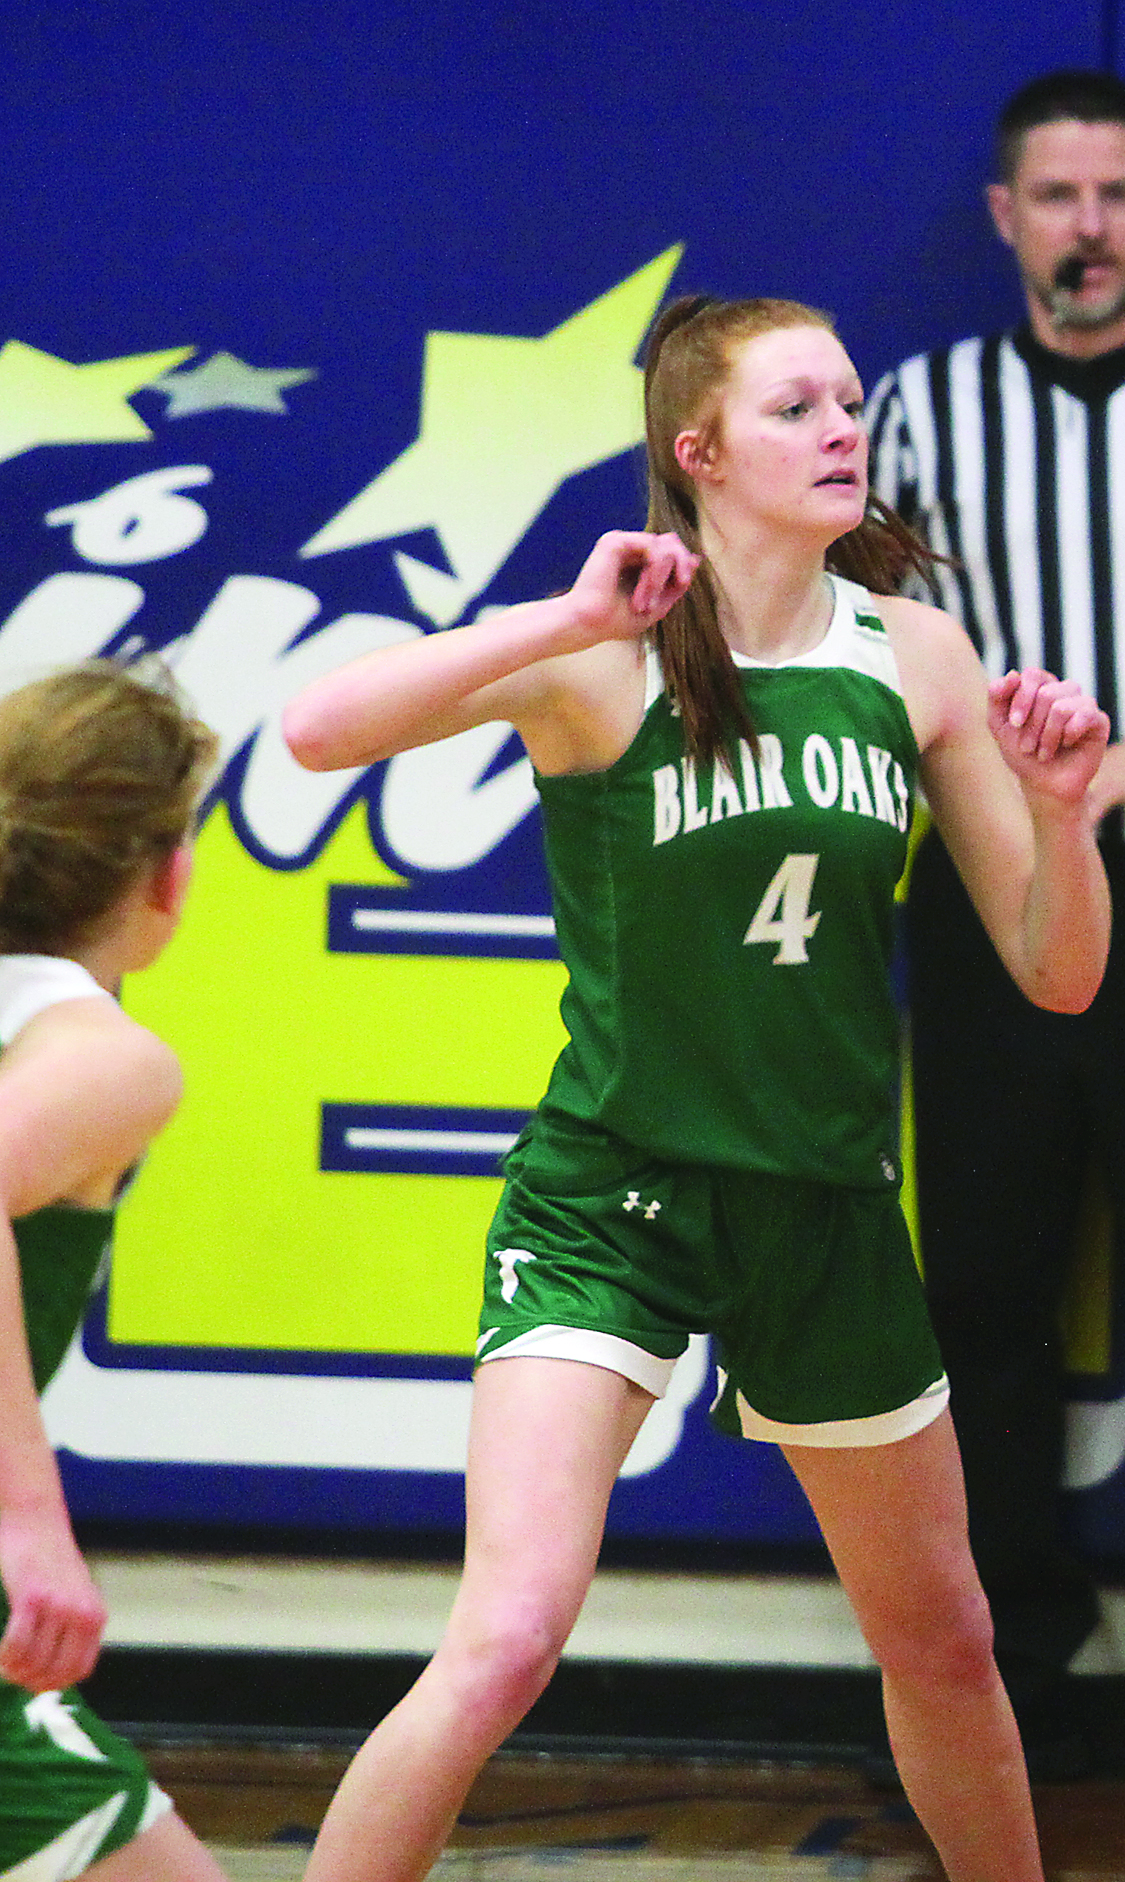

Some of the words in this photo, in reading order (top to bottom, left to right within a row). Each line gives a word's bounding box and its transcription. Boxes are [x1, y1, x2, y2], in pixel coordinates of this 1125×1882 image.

[652, 733, 794, 847] BLAIR
[802, 733, 908, 833] OAKS
[742, 853, 822, 965] 4
